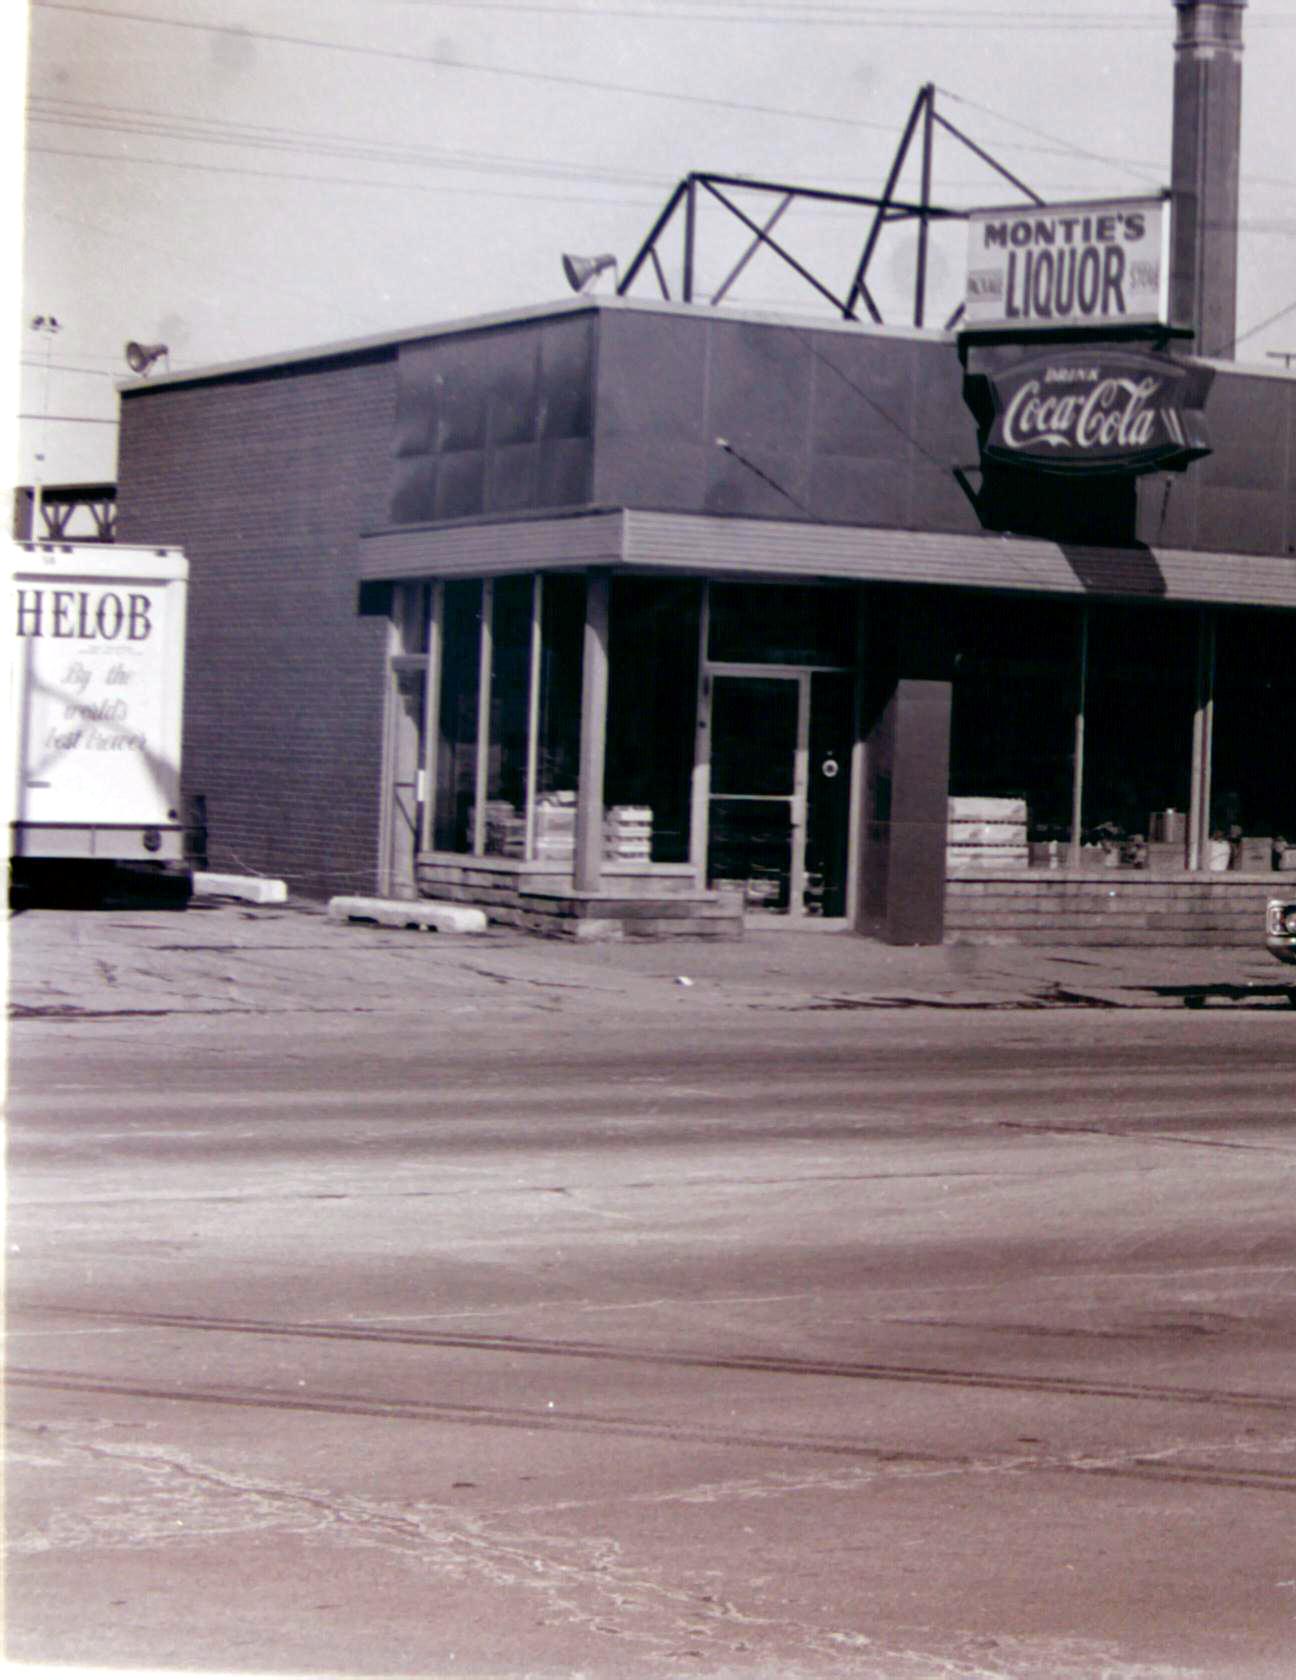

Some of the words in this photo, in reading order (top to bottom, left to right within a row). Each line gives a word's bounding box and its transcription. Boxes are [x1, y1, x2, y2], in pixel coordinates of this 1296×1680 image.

[984, 213, 1146, 248] MONTIE'S
[1005, 245, 1126, 318] LIQUOR
[1044, 367, 1099, 383] DRINK
[16, 589, 152, 641] HELOB
